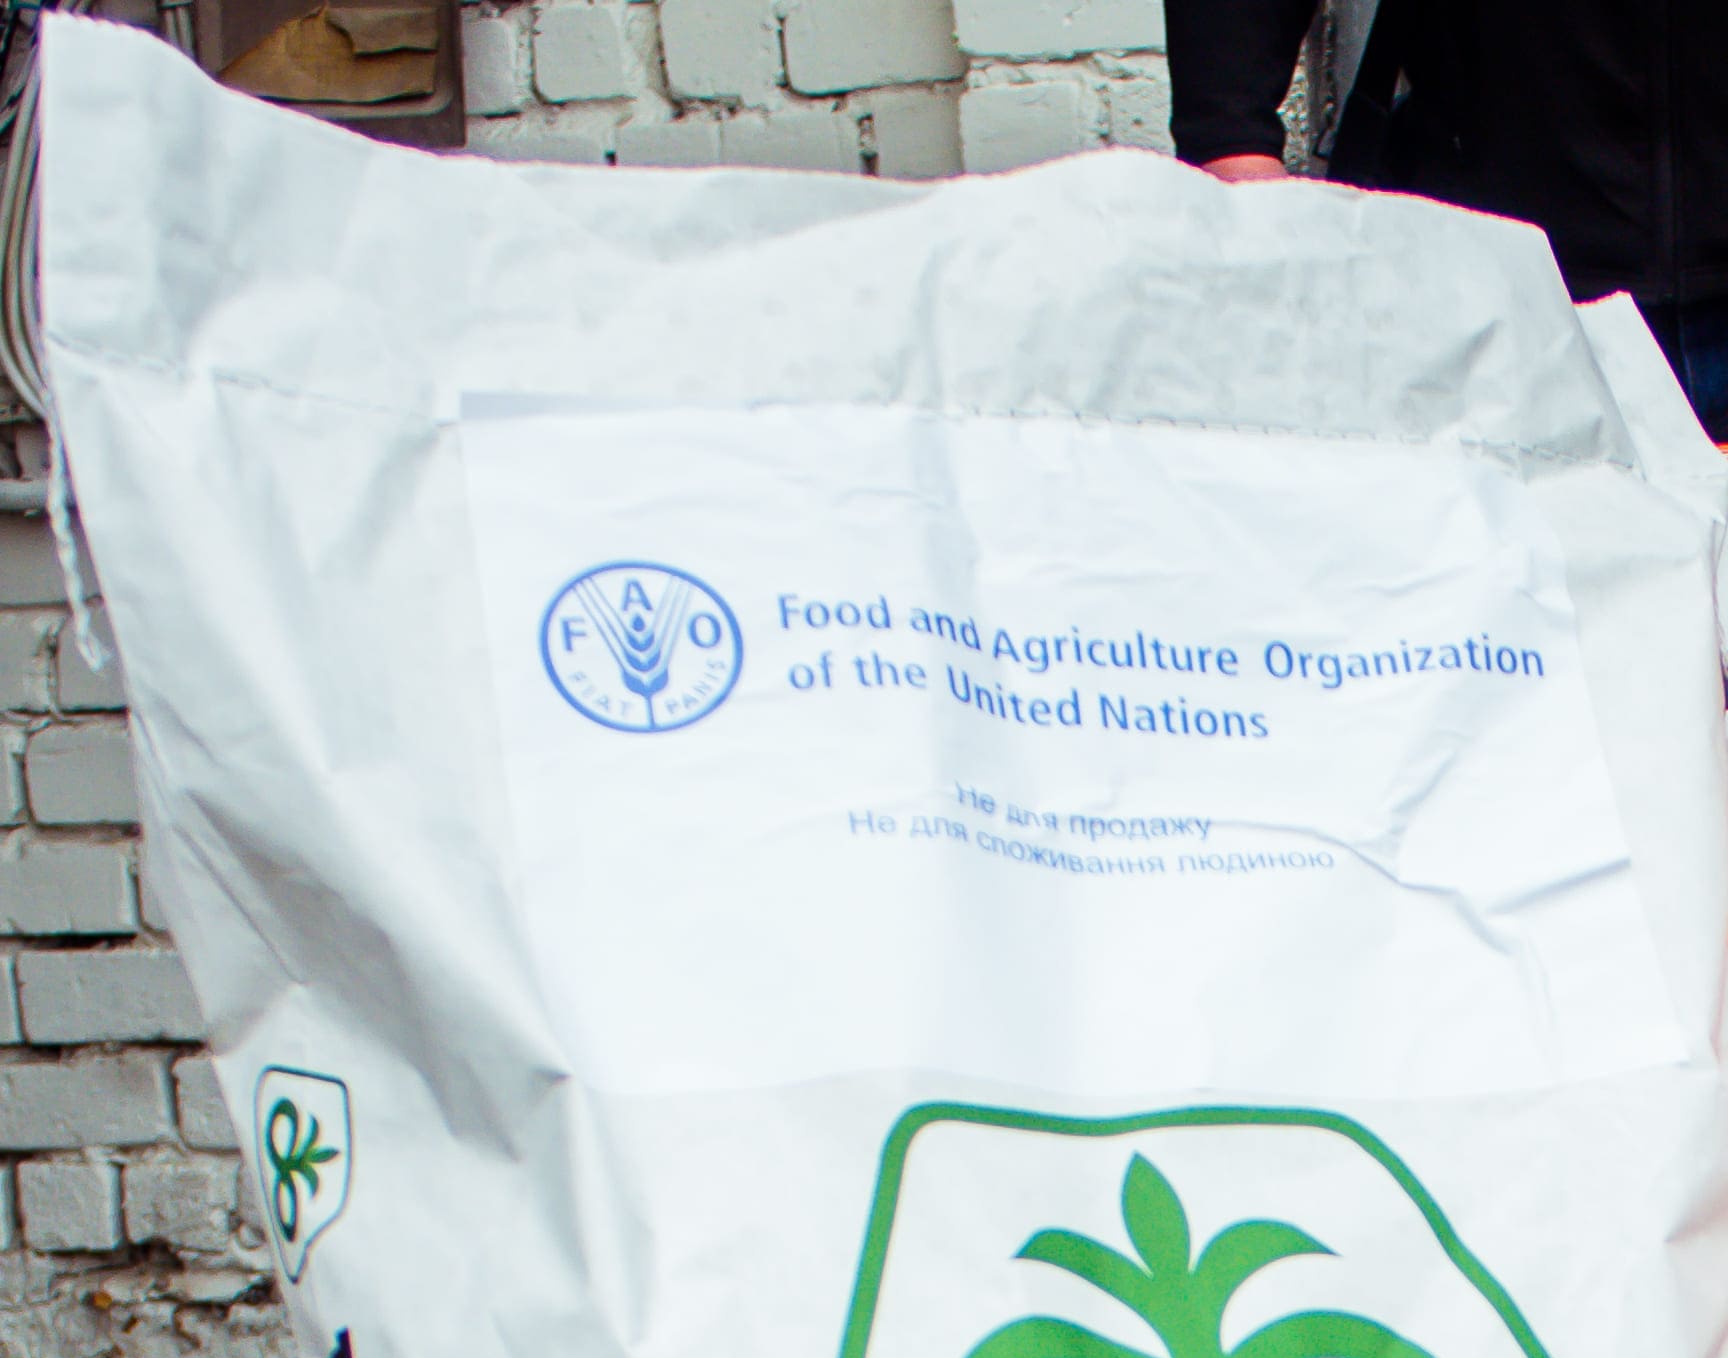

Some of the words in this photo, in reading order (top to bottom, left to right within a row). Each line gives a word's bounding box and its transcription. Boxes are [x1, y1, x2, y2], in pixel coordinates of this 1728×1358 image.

[777, 594, 892, 630] Food
[909, 604, 981, 651] and
[993, 627, 1240, 675] Agriculture
[1265, 633, 1545, 690] Organization
[789, 651, 833, 690] of
[853, 652, 927, 688] the
[947, 664, 1081, 726] United
[1099, 694, 1269, 739] Nations
[848, 811, 896, 835] Не
[909, 814, 968, 842] для
[976, 829, 1166, 874] споживання
[1177, 850, 1335, 875] людиною
[956, 781, 995, 814] Не
[1006, 803, 1057, 831] для
[1069, 813, 1212, 842] продажу
